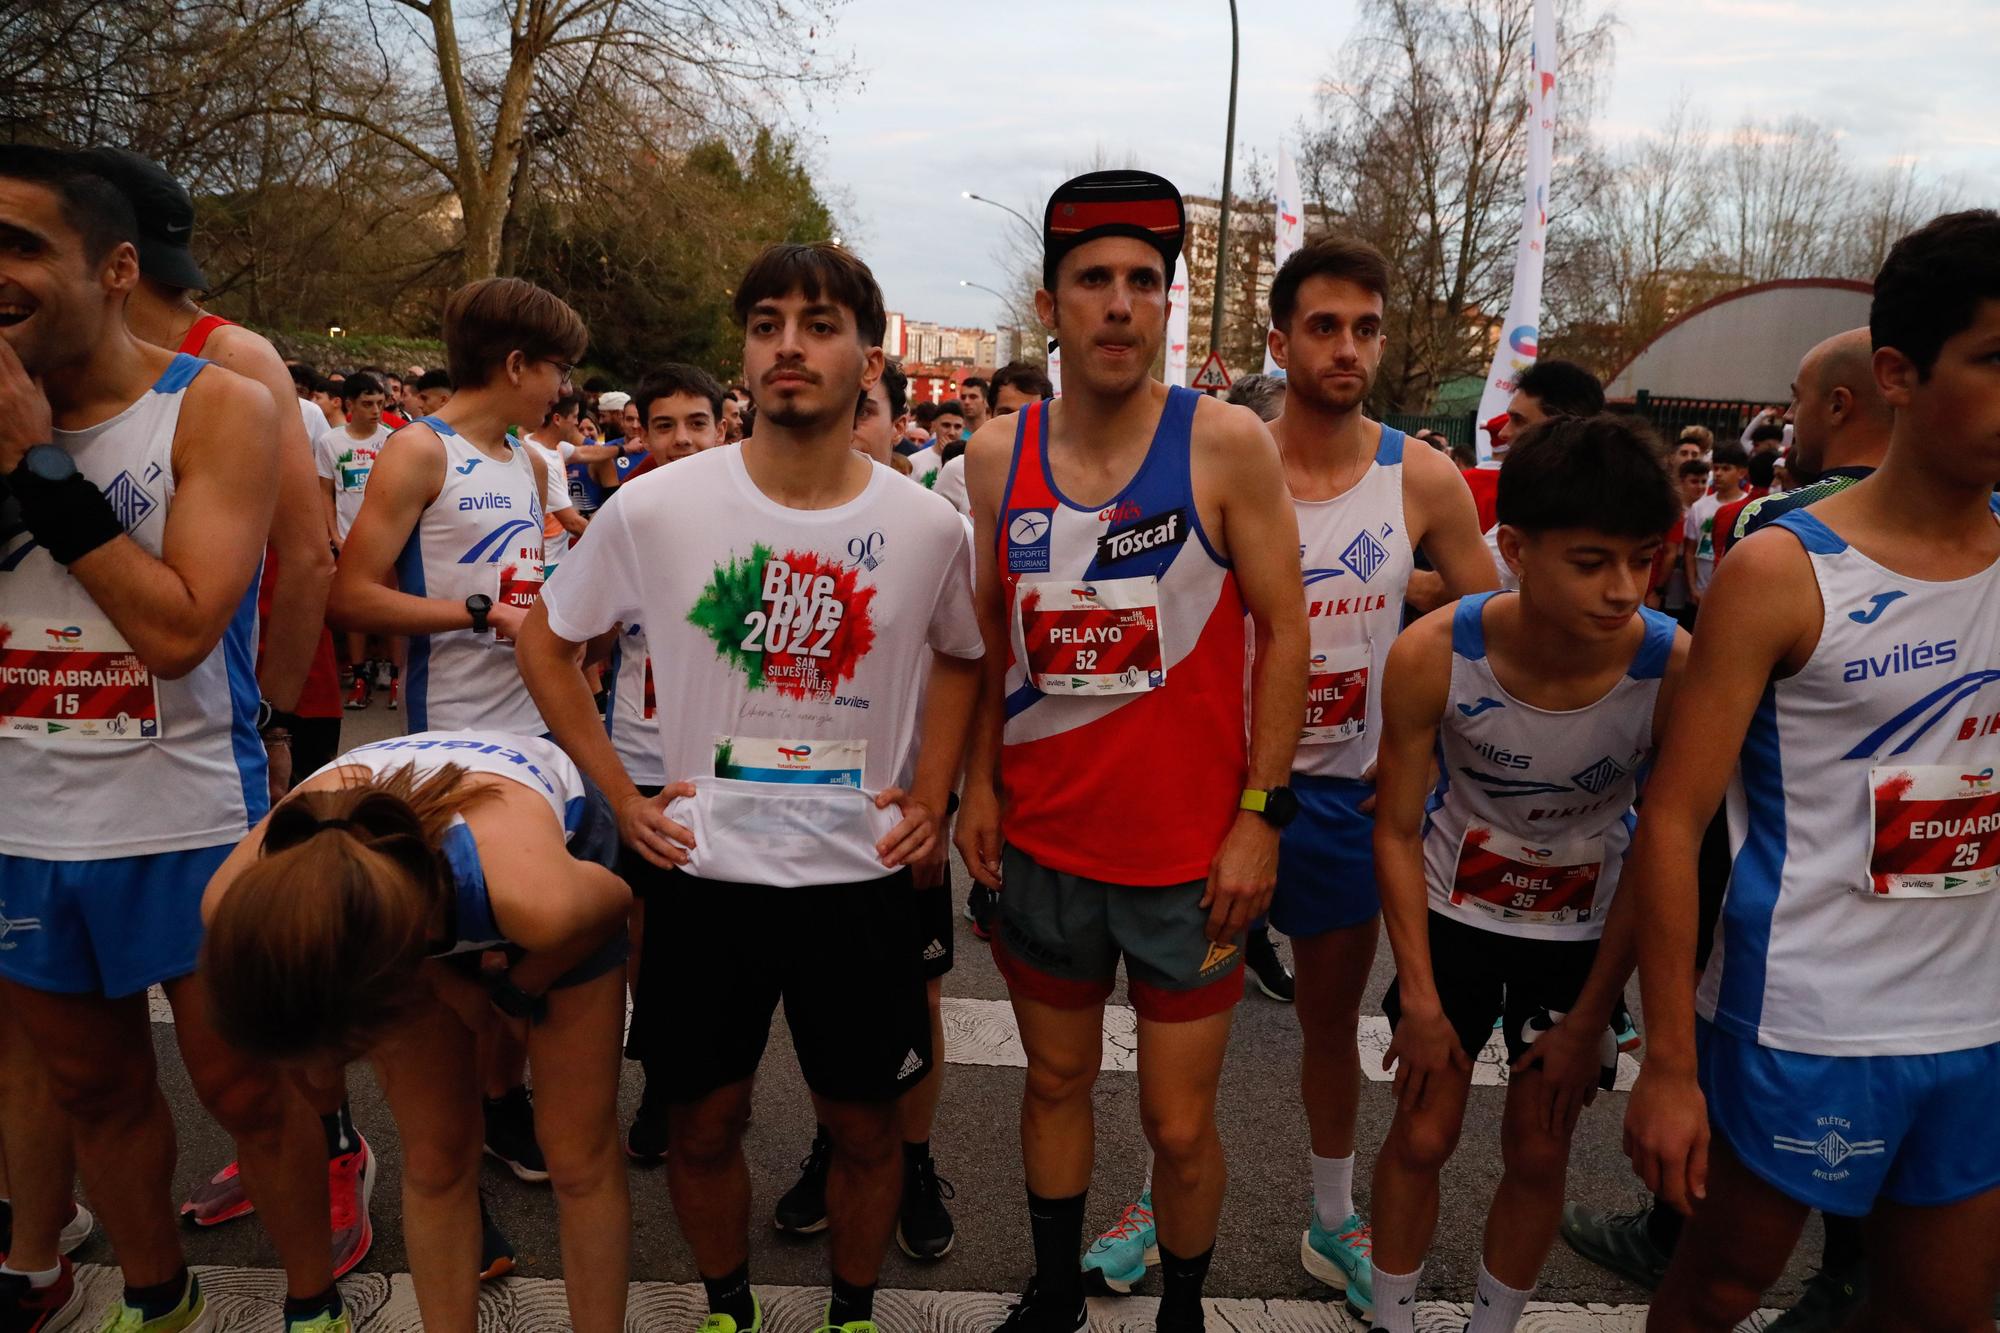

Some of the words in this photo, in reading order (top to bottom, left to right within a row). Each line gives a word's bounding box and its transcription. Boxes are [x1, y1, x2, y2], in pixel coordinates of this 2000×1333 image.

[459, 492, 512, 512] avilés
[1099, 500, 1142, 526] cafés
[1106, 514, 1178, 560] Toscaf
[1009, 549, 1047, 559] DEPORTE
[1009, 559, 1047, 569] ASTURIANO
[740, 611, 837, 658] 2022
[1050, 627, 1123, 644] PELAYO
[795, 656, 816, 669] SAN
[1076, 650, 1098, 670] 52
[1843, 639, 1957, 683] avilés
[53, 670, 149, 687] ABRAHAM
[768, 665, 820, 680] SILVESTRE
[54, 694, 81, 715] 15
[1304, 706, 1324, 724] 12
[1909, 811, 2000, 840] EDUARD
[1952, 842, 1980, 867] 25
[1501, 872, 1553, 891] ABEL
[1511, 893, 1537, 908] 35
[897, 1057, 923, 1080] adidas
[1816, 1114, 1851, 1129] ATLÉTICA
[1811, 1168, 1851, 1182] AVILESINA
